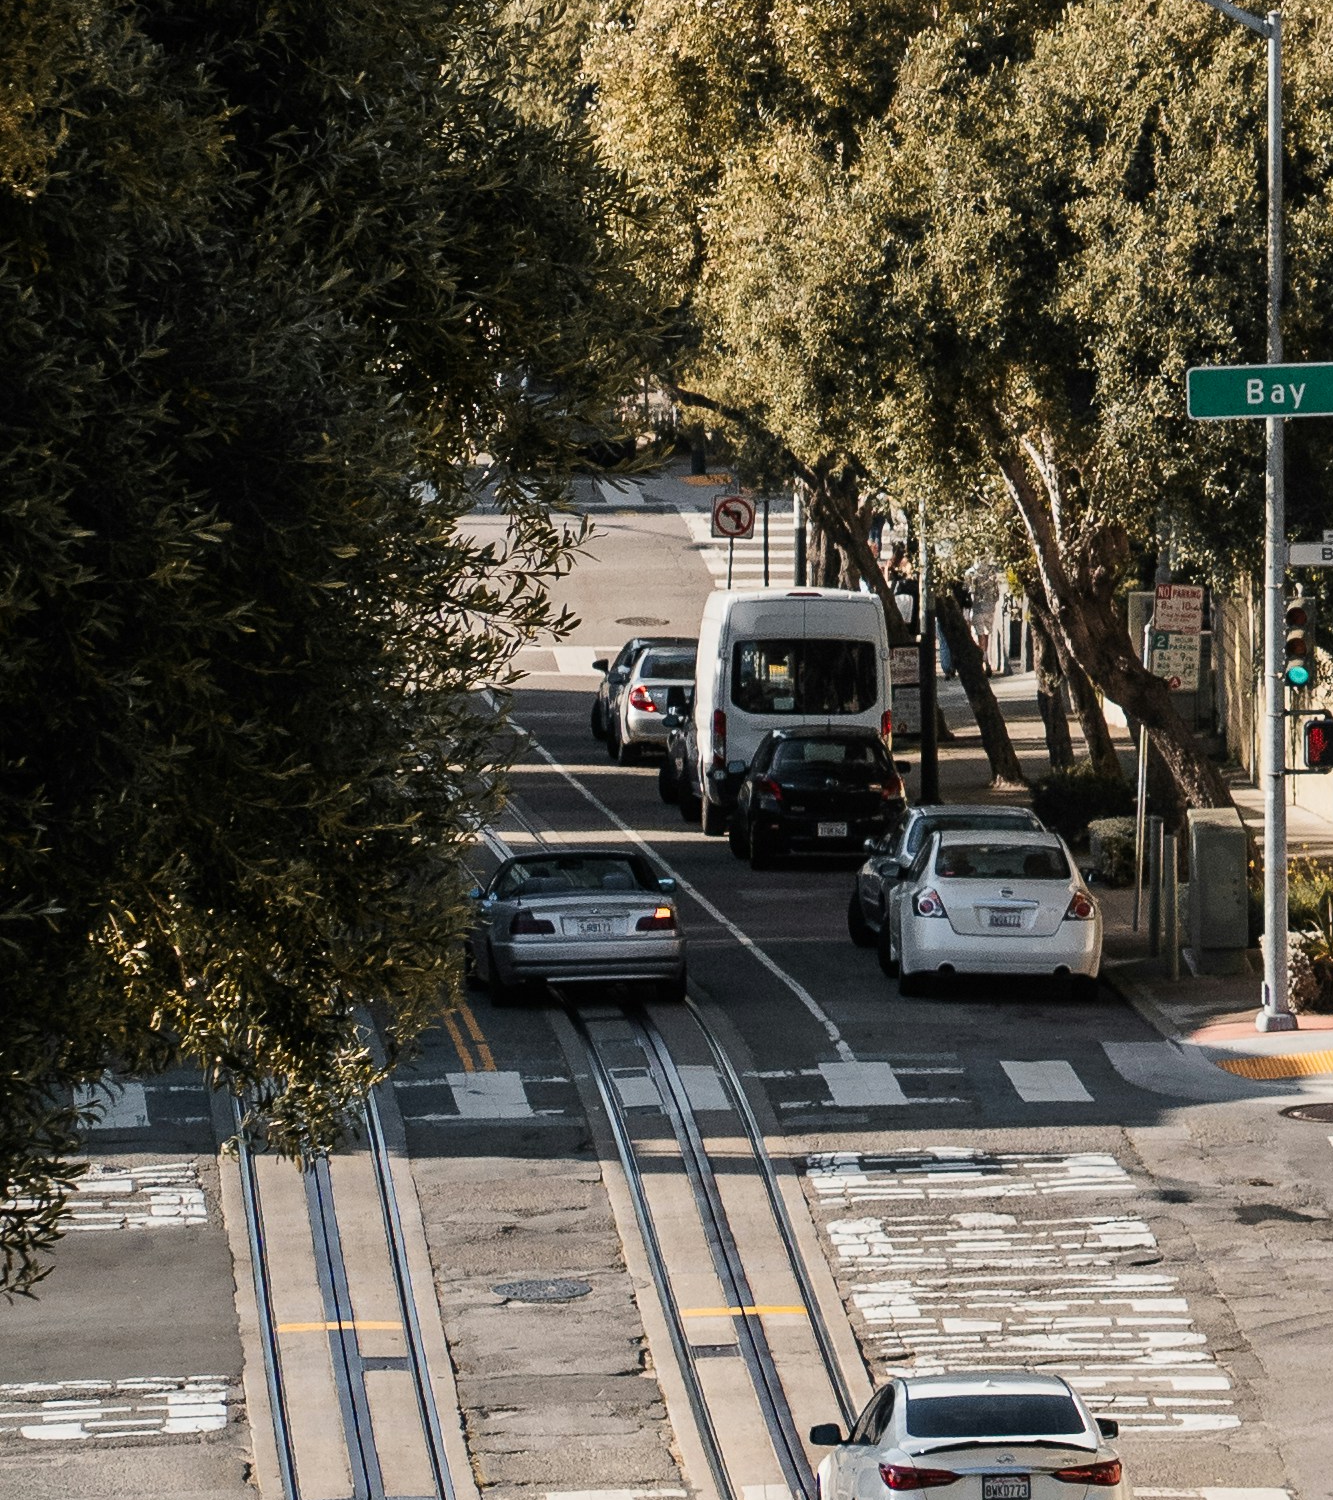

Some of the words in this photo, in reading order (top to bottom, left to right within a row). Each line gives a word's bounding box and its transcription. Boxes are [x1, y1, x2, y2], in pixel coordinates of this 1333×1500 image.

[1246, 378, 1306, 409] Bay
[1173, 588, 1202, 600] PARKING
[1157, 635, 1166, 648] 2
